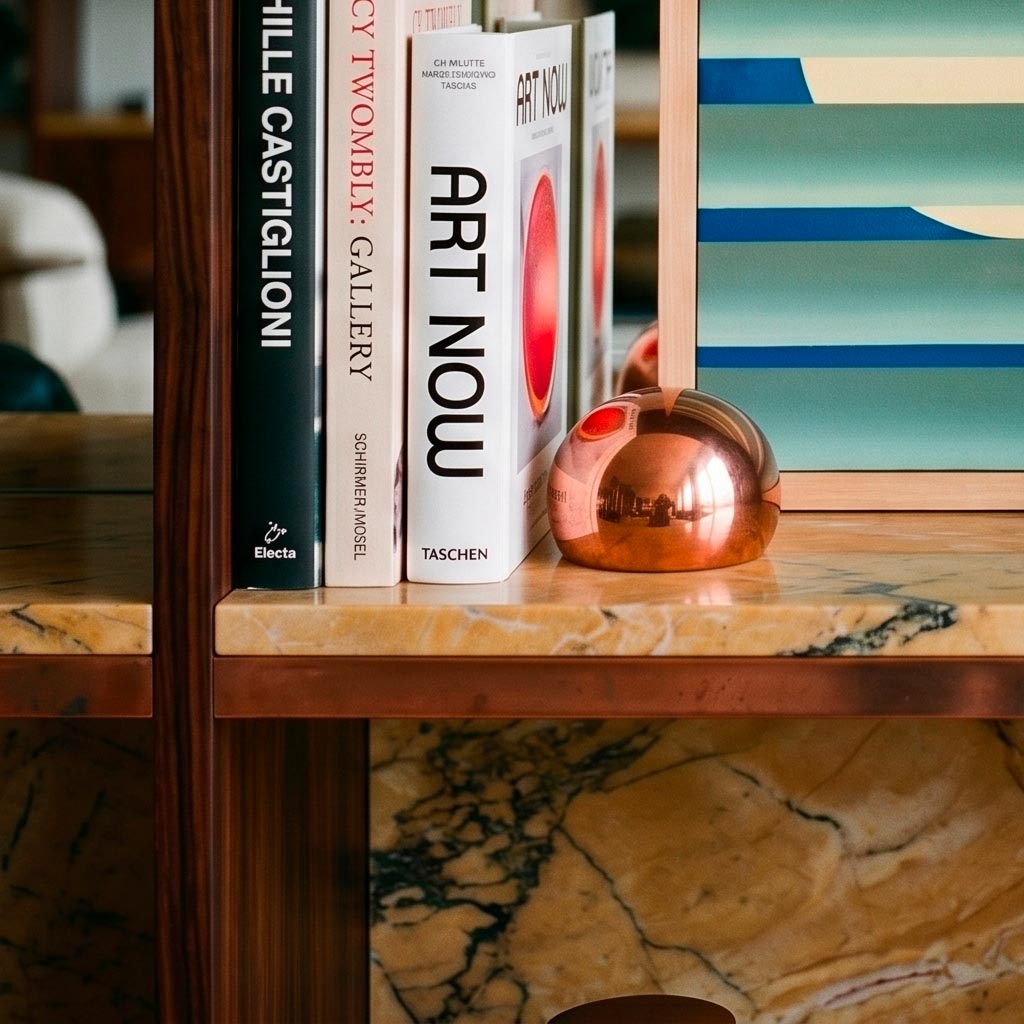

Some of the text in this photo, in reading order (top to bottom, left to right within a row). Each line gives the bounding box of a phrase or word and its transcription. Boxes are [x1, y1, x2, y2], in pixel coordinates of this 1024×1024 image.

[350, 49, 375, 225] TWOMBLY:
[516, 69, 540, 127] ART
[542, 62, 568, 119] NOW
[260, 106, 293, 348] CASTIGLIONI
[349, 236, 374, 382] GALLERY
[426, 165, 488, 478] ART NOW
[254, 546, 297, 559] Electa
[421, 547, 488, 561] TASCHEN
